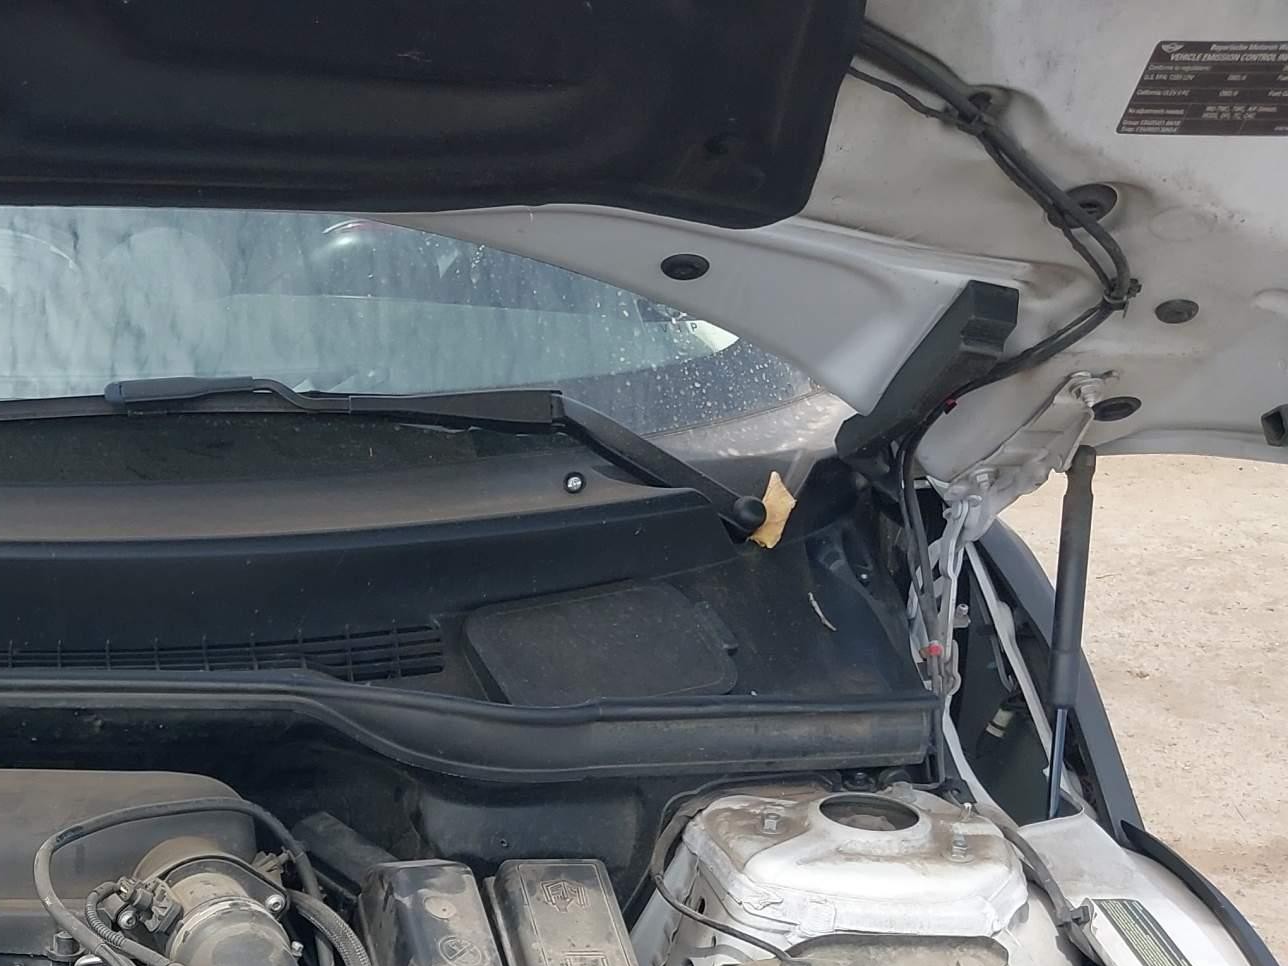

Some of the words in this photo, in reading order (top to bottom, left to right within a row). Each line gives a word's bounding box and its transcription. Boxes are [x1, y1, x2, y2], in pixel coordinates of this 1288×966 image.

[1170, 53, 1202, 62] VEHICLE
[1202, 53, 1240, 62] EMISSION
[1240, 53, 1276, 62] CONTROL
